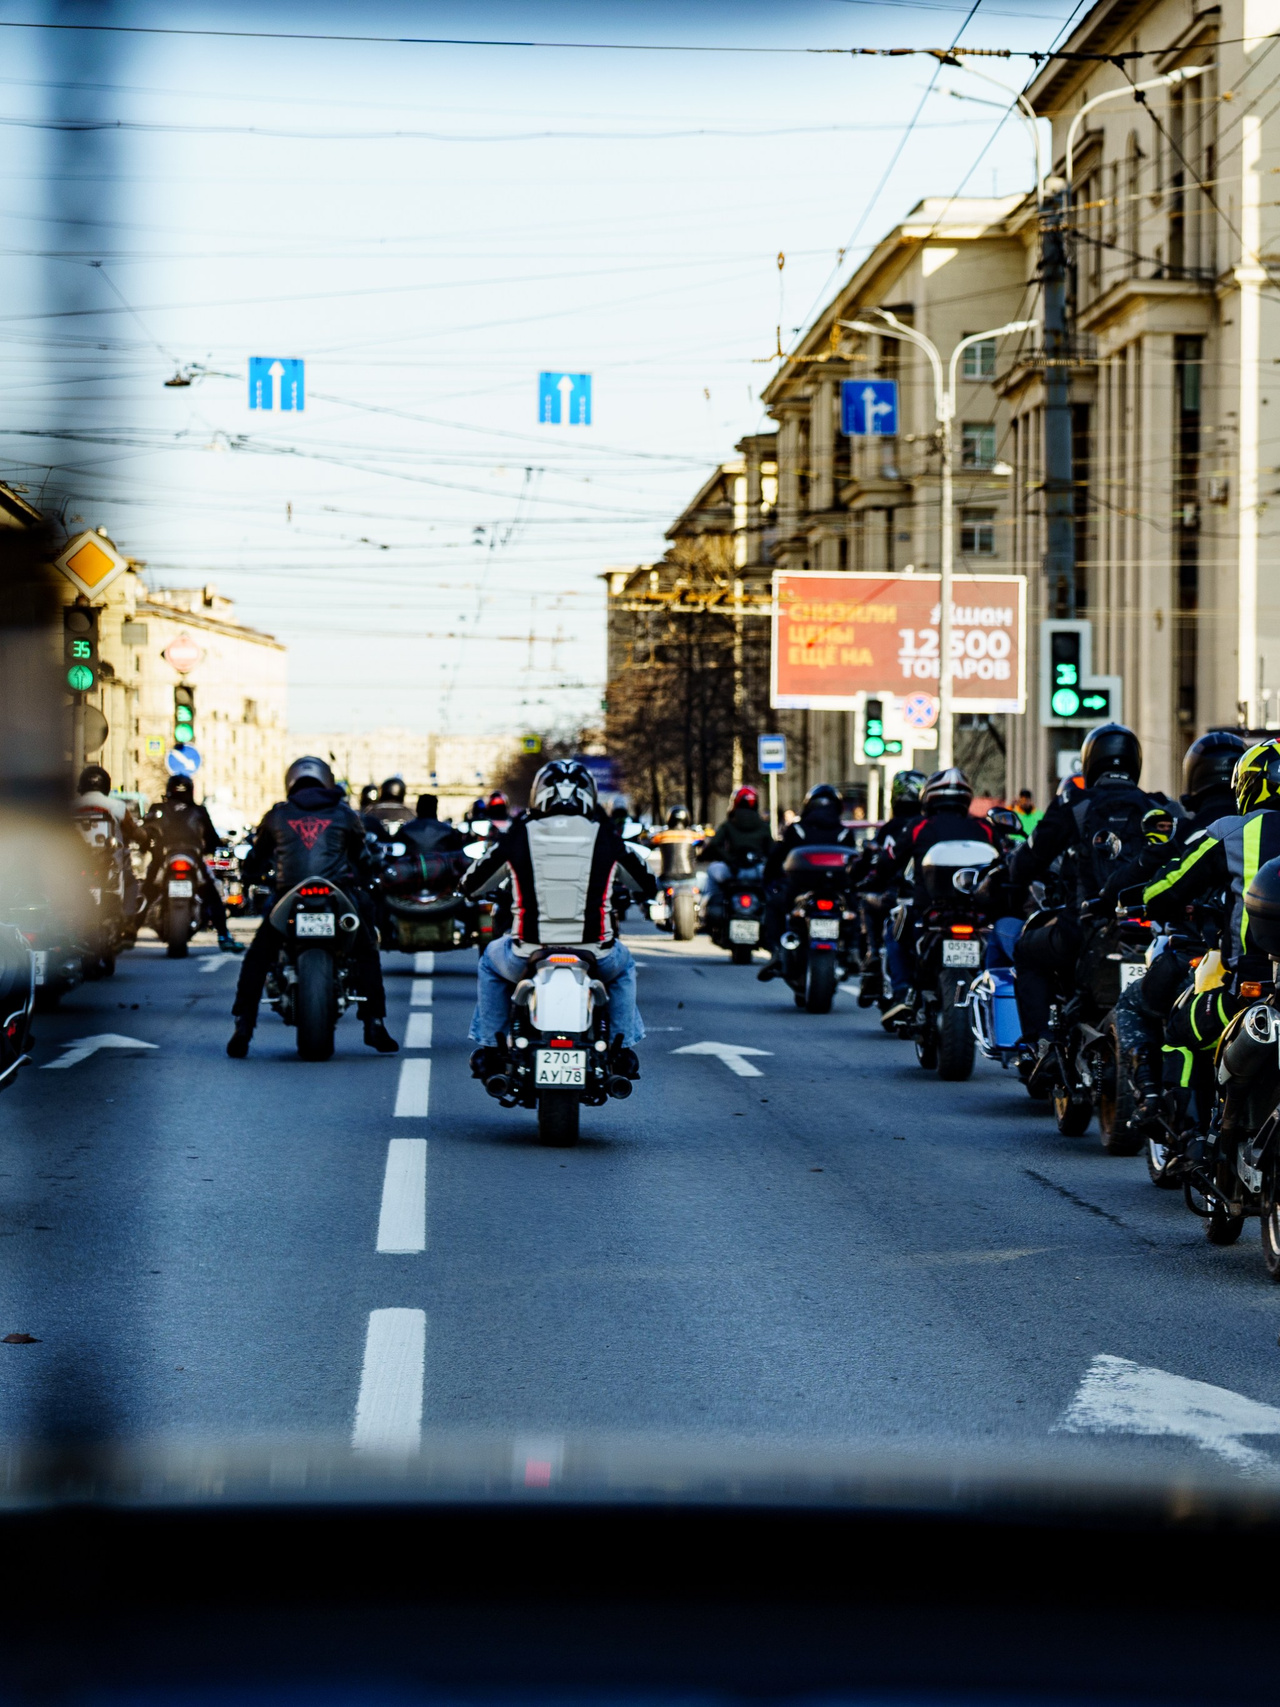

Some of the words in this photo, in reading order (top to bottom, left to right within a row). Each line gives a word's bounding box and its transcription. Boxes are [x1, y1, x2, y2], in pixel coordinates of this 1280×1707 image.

[788, 624, 855, 646] ЦЕНЫ
[73, 640, 91, 659] 35
[840, 647, 874, 667] НА
[543, 1051, 580, 1064] 2701
[565, 1070, 582, 1083] 78
